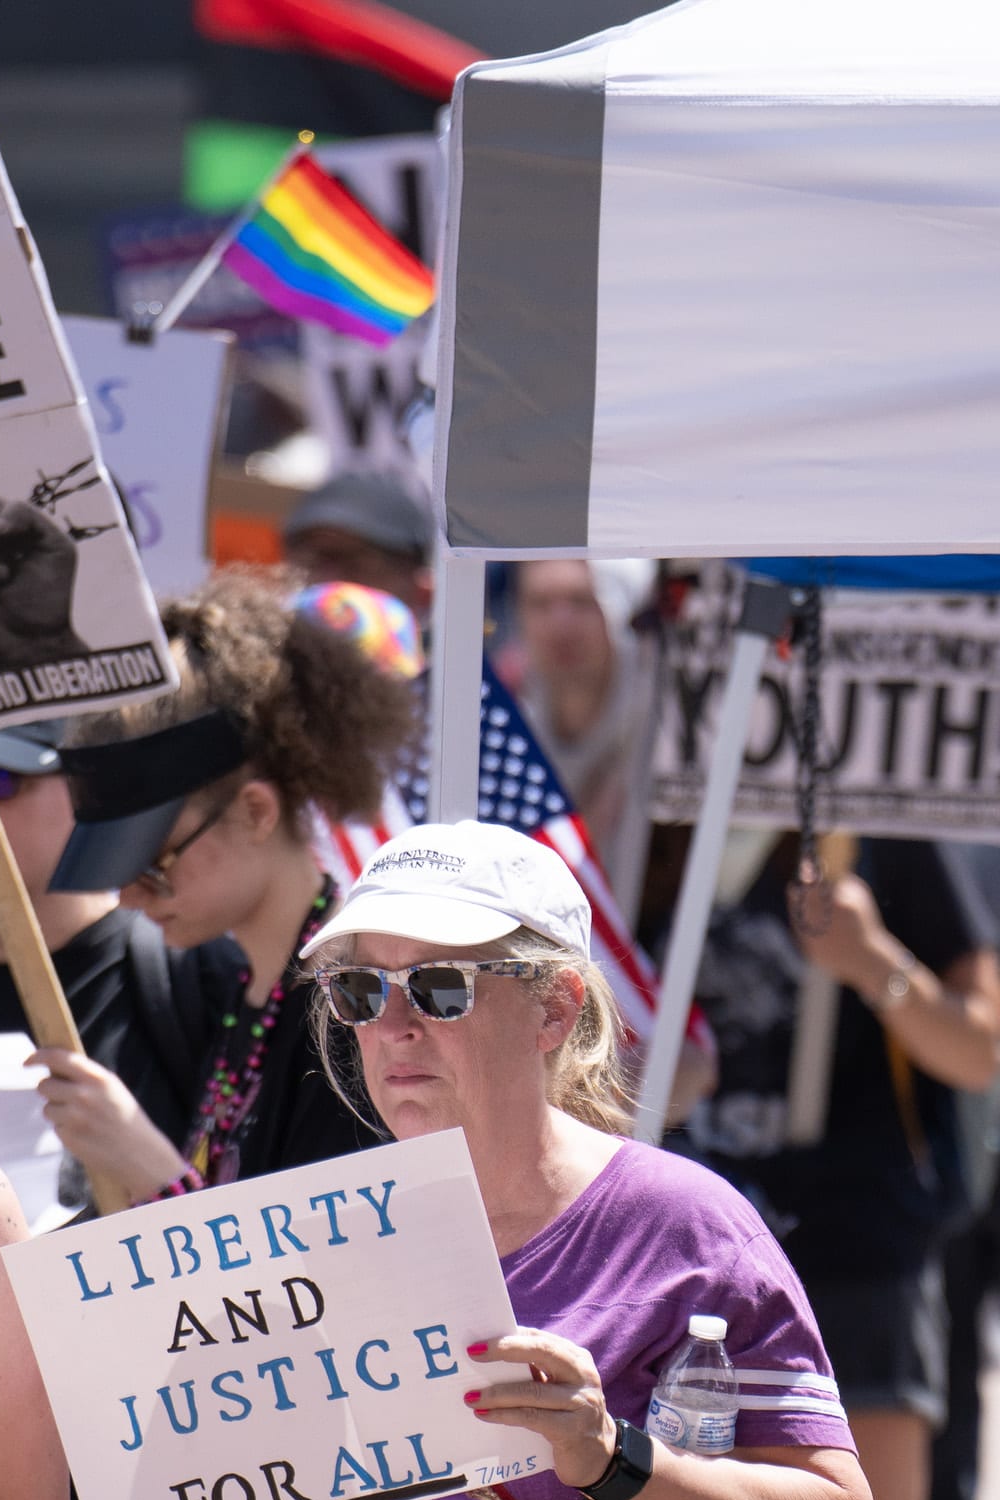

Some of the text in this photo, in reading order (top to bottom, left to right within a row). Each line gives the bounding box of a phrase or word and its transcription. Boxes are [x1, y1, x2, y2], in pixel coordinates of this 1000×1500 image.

[25, 647, 162, 703] LIBERATION
[65, 1179, 398, 1302] LIBERTY
[167, 1276, 325, 1353] AND
[119, 1323, 460, 1451] JUSTICE
[328, 1432, 453, 1498] ALL
